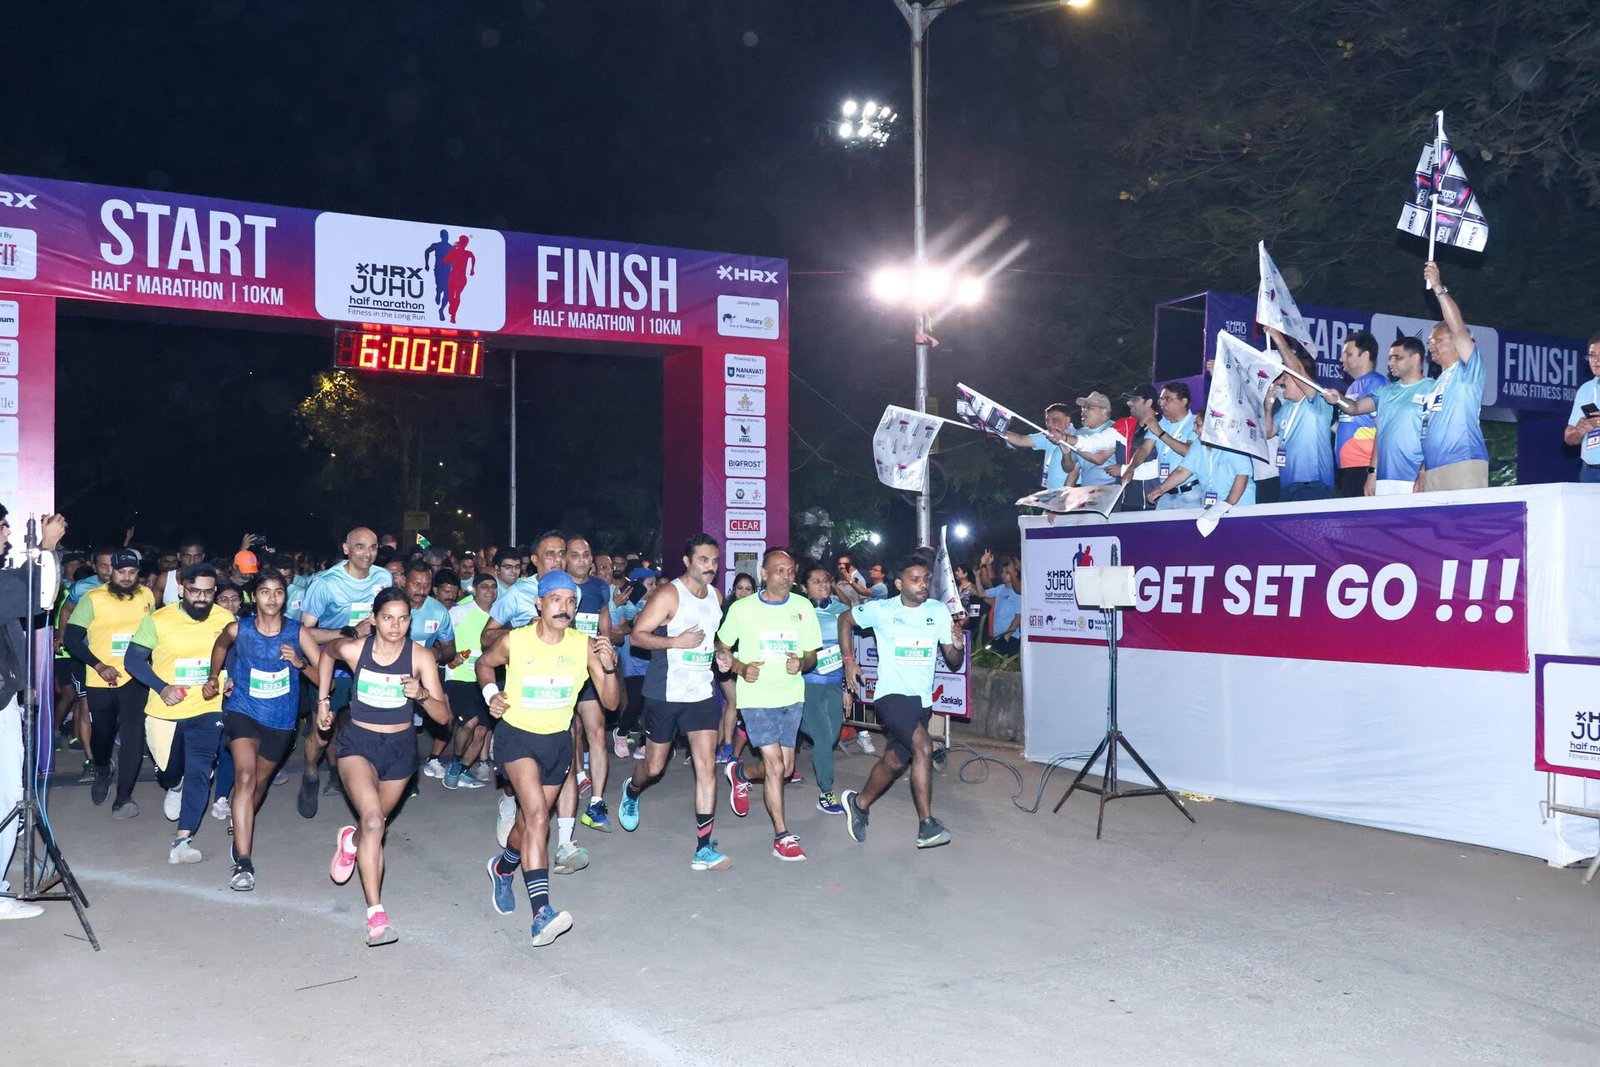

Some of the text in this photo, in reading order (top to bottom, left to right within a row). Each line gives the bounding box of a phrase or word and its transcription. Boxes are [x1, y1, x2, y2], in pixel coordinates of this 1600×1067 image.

[0, 191, 37, 209] RX
[100, 199, 277, 279] START
[371, 264, 423, 280] HRX
[537, 245, 678, 313] FINISH
[734, 268, 779, 284] HRX
[91, 270, 132, 292] HALF
[136, 275, 224, 300] MARATHON
[242, 285, 284, 306] 10KM
[350, 275, 424, 299] JUHU
[349, 296, 424, 310] half marathon
[348, 308, 372, 317] Fitness
[394, 312, 411, 321] Long
[533, 309, 565, 327] HALF
[568, 312, 635, 332] MARATHON
[649, 318, 681, 336] 10KM
[1303, 317, 1364, 360] TART
[359, 334, 479, 375] 6:00:01
[736, 367, 764, 375] NANAVATI
[1316, 363, 1344, 379] TNES
[1505, 342, 1578, 387] FINISH
[1503, 384, 1509, 395] 4
[1509, 384, 1528, 397] KMS
[1529, 386, 1562, 400] FITNESS
[729, 460, 761, 468] BIOFROST
[730, 521, 759, 530] CLEAR
[1052, 570, 1072, 578] HRX
[1045, 579, 1073, 591] JUHU
[1135, 558, 1520, 624] GET SET GO !!!
[1063, 618, 1076, 626] Rotary
[941, 695, 962, 707] Sankalp
[1571, 722, 1600, 741] JU
[1570, 741, 1587, 750] half
